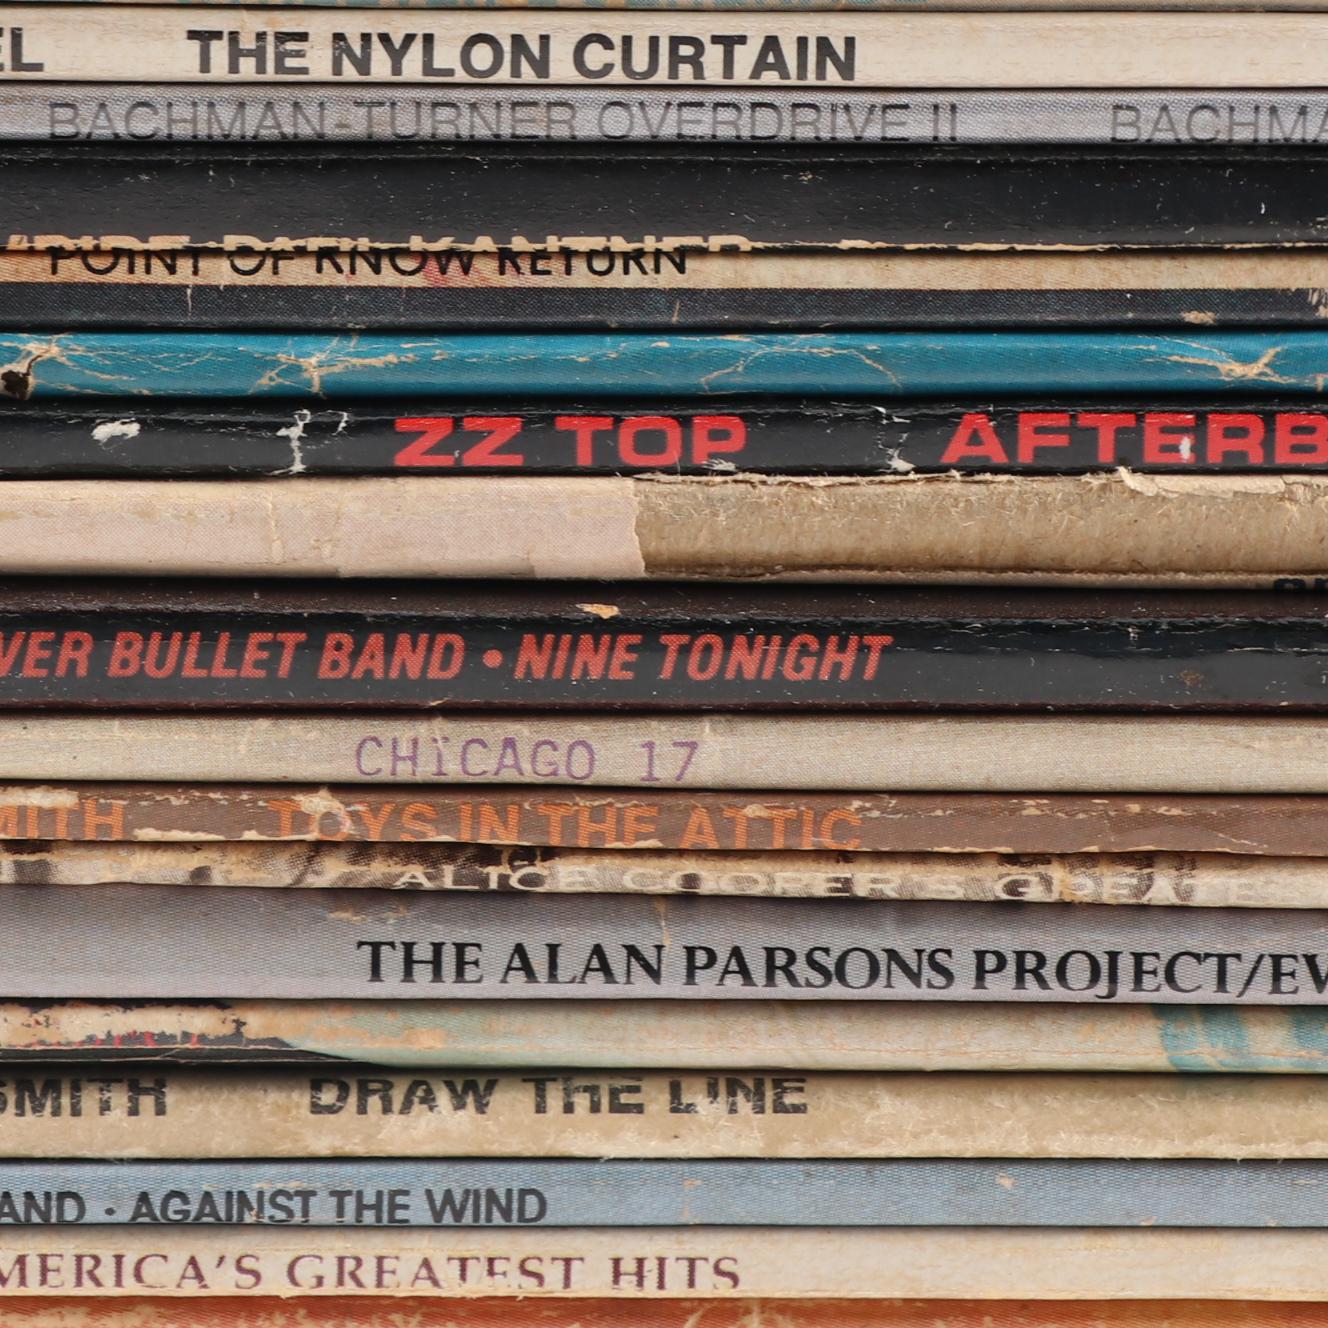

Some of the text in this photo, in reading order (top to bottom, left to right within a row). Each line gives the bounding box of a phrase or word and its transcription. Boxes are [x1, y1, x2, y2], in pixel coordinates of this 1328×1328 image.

[185, 28, 311, 74] THE
[331, 30, 553, 80] NYLON
[571, 34, 857, 82] CURTAIN
[49, 99, 577, 141] BACHMAN-TURNER
[596, 99, 912, 143] OVERDRIVE
[393, 415, 526, 468] ZZ
[555, 414, 748, 467] TOP
[107, 631, 309, 681] BULLET
[317, 631, 467, 682] BAND
[513, 632, 646, 682] NINE
[657, 633, 895, 682] TONIGHT
[355, 735, 597, 782] CHICAGO
[640, 739, 700, 783] 17
[268, 800, 438, 843] TOYS
[459, 802, 522, 846] IN
[538, 803, 660, 849] THE
[680, 805, 865, 851] ATTIC
[355, 940, 484, 985] THE
[498, 942, 668, 987] ALAN
[681, 945, 956, 990] PARSONS
[308, 1076, 497, 1116] DRAW
[521, 1076, 645, 1116] THE
[668, 1076, 808, 1116] LINE
[129, 1189, 318, 1225] AGAINST
[328, 1189, 410, 1225] THE
[424, 1187, 548, 1225] WIND
[285, 1253, 586, 1290] GREATEST
[607, 1253, 741, 1292] HITS
